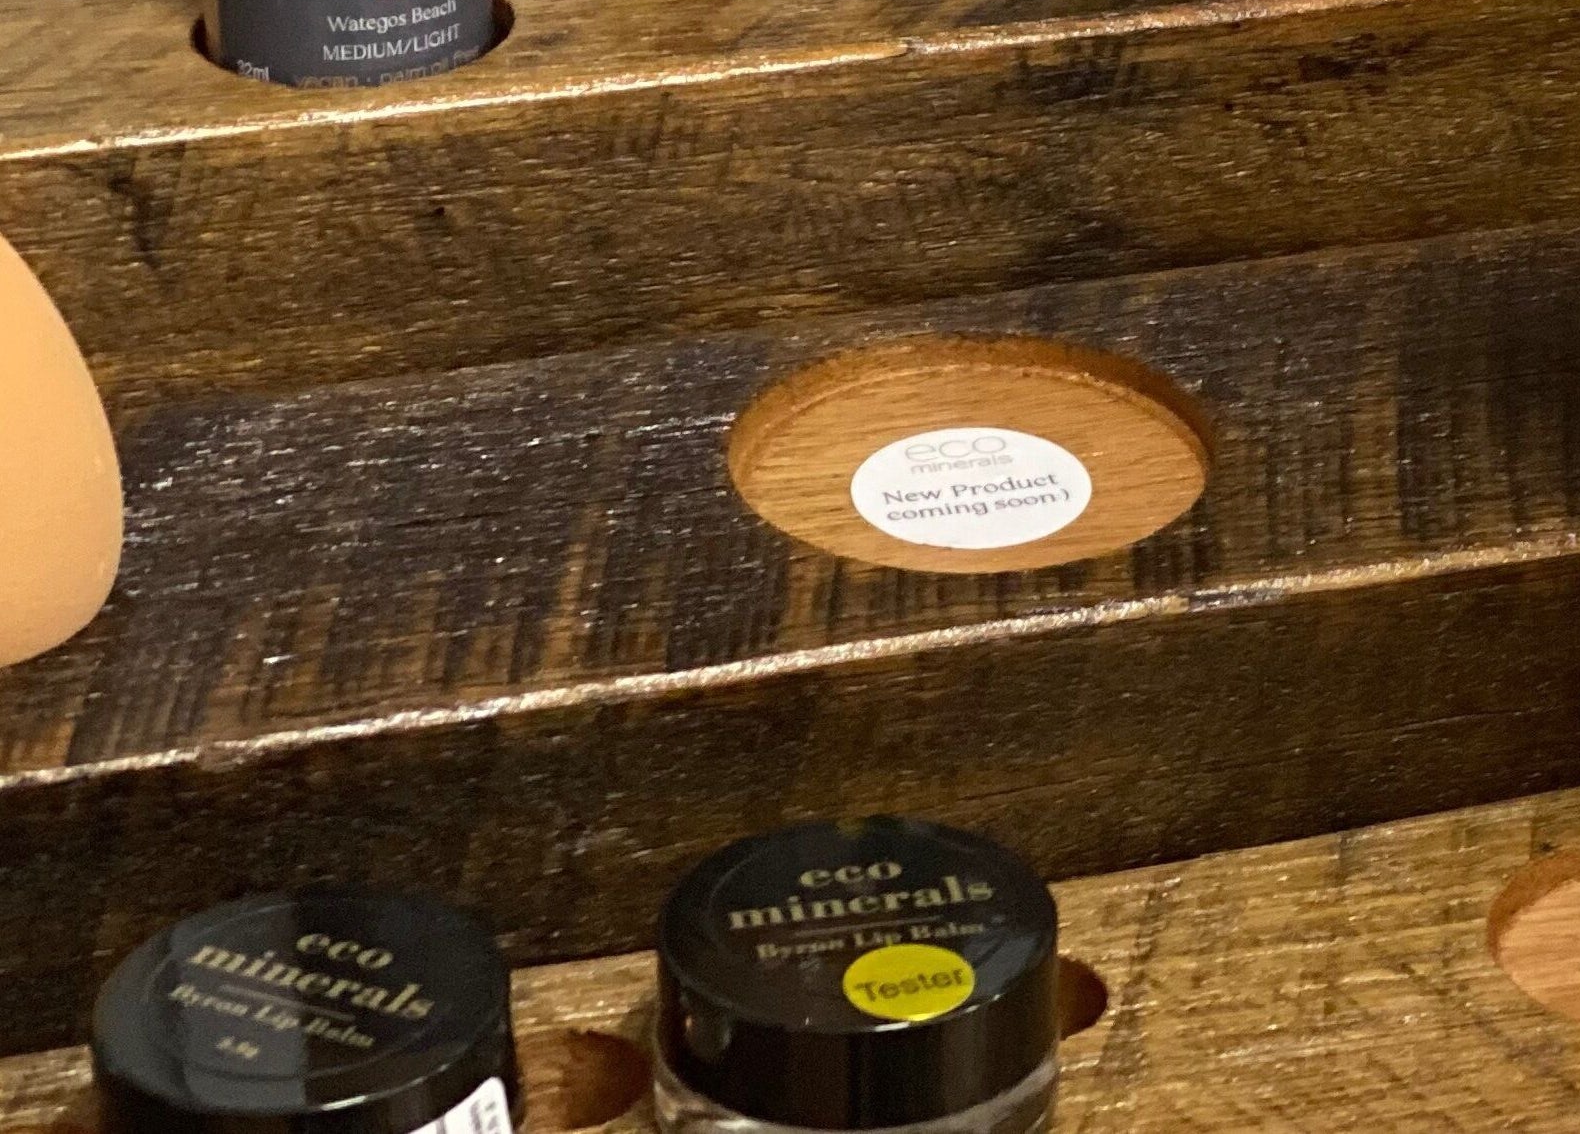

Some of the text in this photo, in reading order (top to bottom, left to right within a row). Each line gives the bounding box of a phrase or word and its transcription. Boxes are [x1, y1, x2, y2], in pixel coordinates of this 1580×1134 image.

[326, 11, 407, 35] Wategos
[322, 23, 461, 62] MEDIUM/LIGHT
[904, 435, 1007, 463] eco
[910, 453, 1014, 476] minerals
[880, 472, 1061, 506] New Product
[886, 497, 989, 522] coming
[800, 860, 902, 889] eco
[728, 874, 995, 930] minerals
[296, 932, 394, 970] eco
[186, 944, 436, 1019] minerals
[853, 967, 965, 1002] Tester
